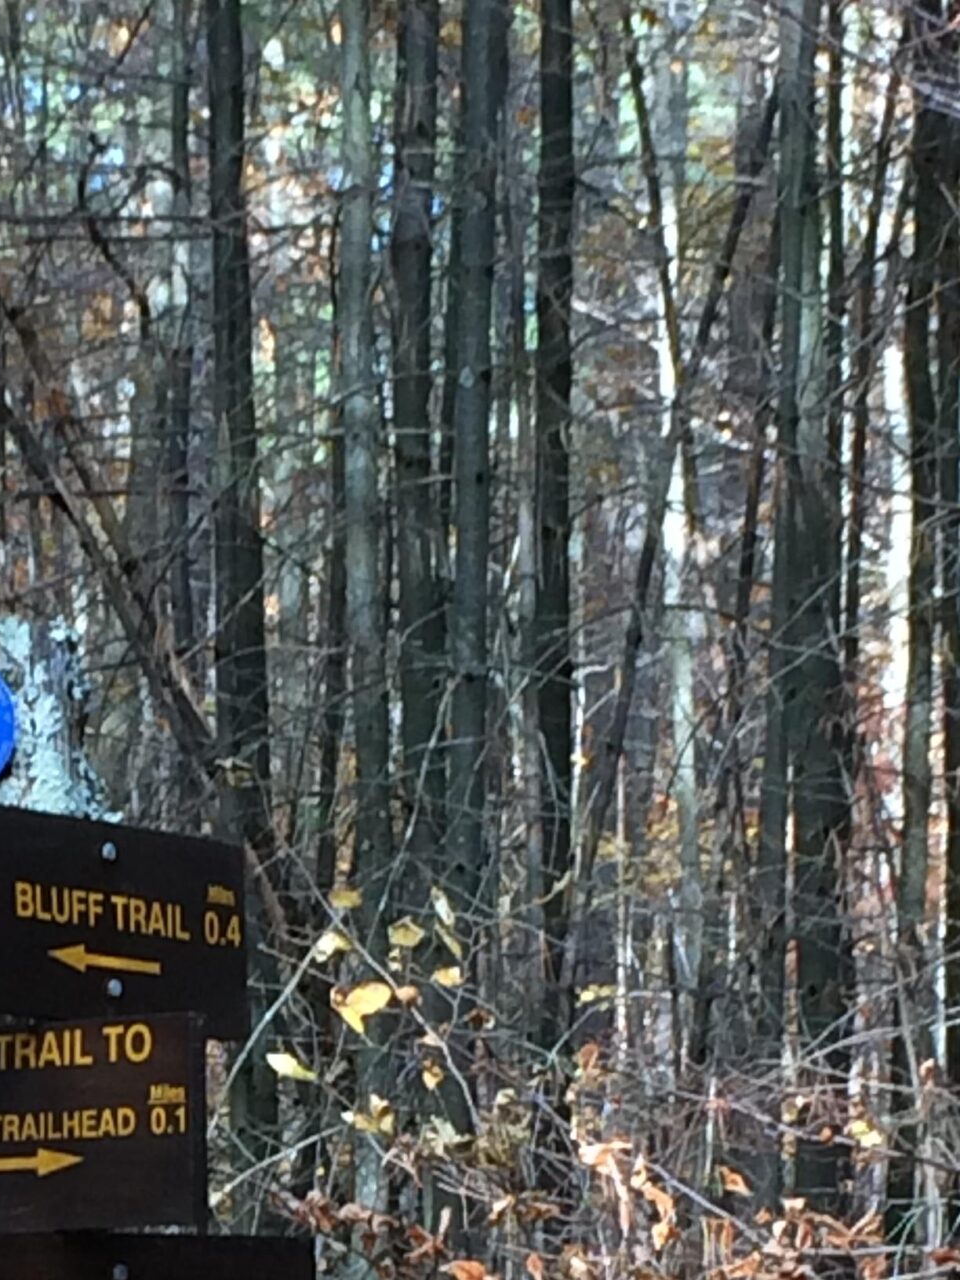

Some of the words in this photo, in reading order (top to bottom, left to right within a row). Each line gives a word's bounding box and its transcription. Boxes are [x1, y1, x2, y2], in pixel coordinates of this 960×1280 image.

[14, 881, 104, 928] BLUFF
[110, 895, 191, 941] TRAIL
[204, 911, 241, 948] 0.4
[102, 1023, 153, 1064] TO
[150, 1106, 187, 1136] 0.1
